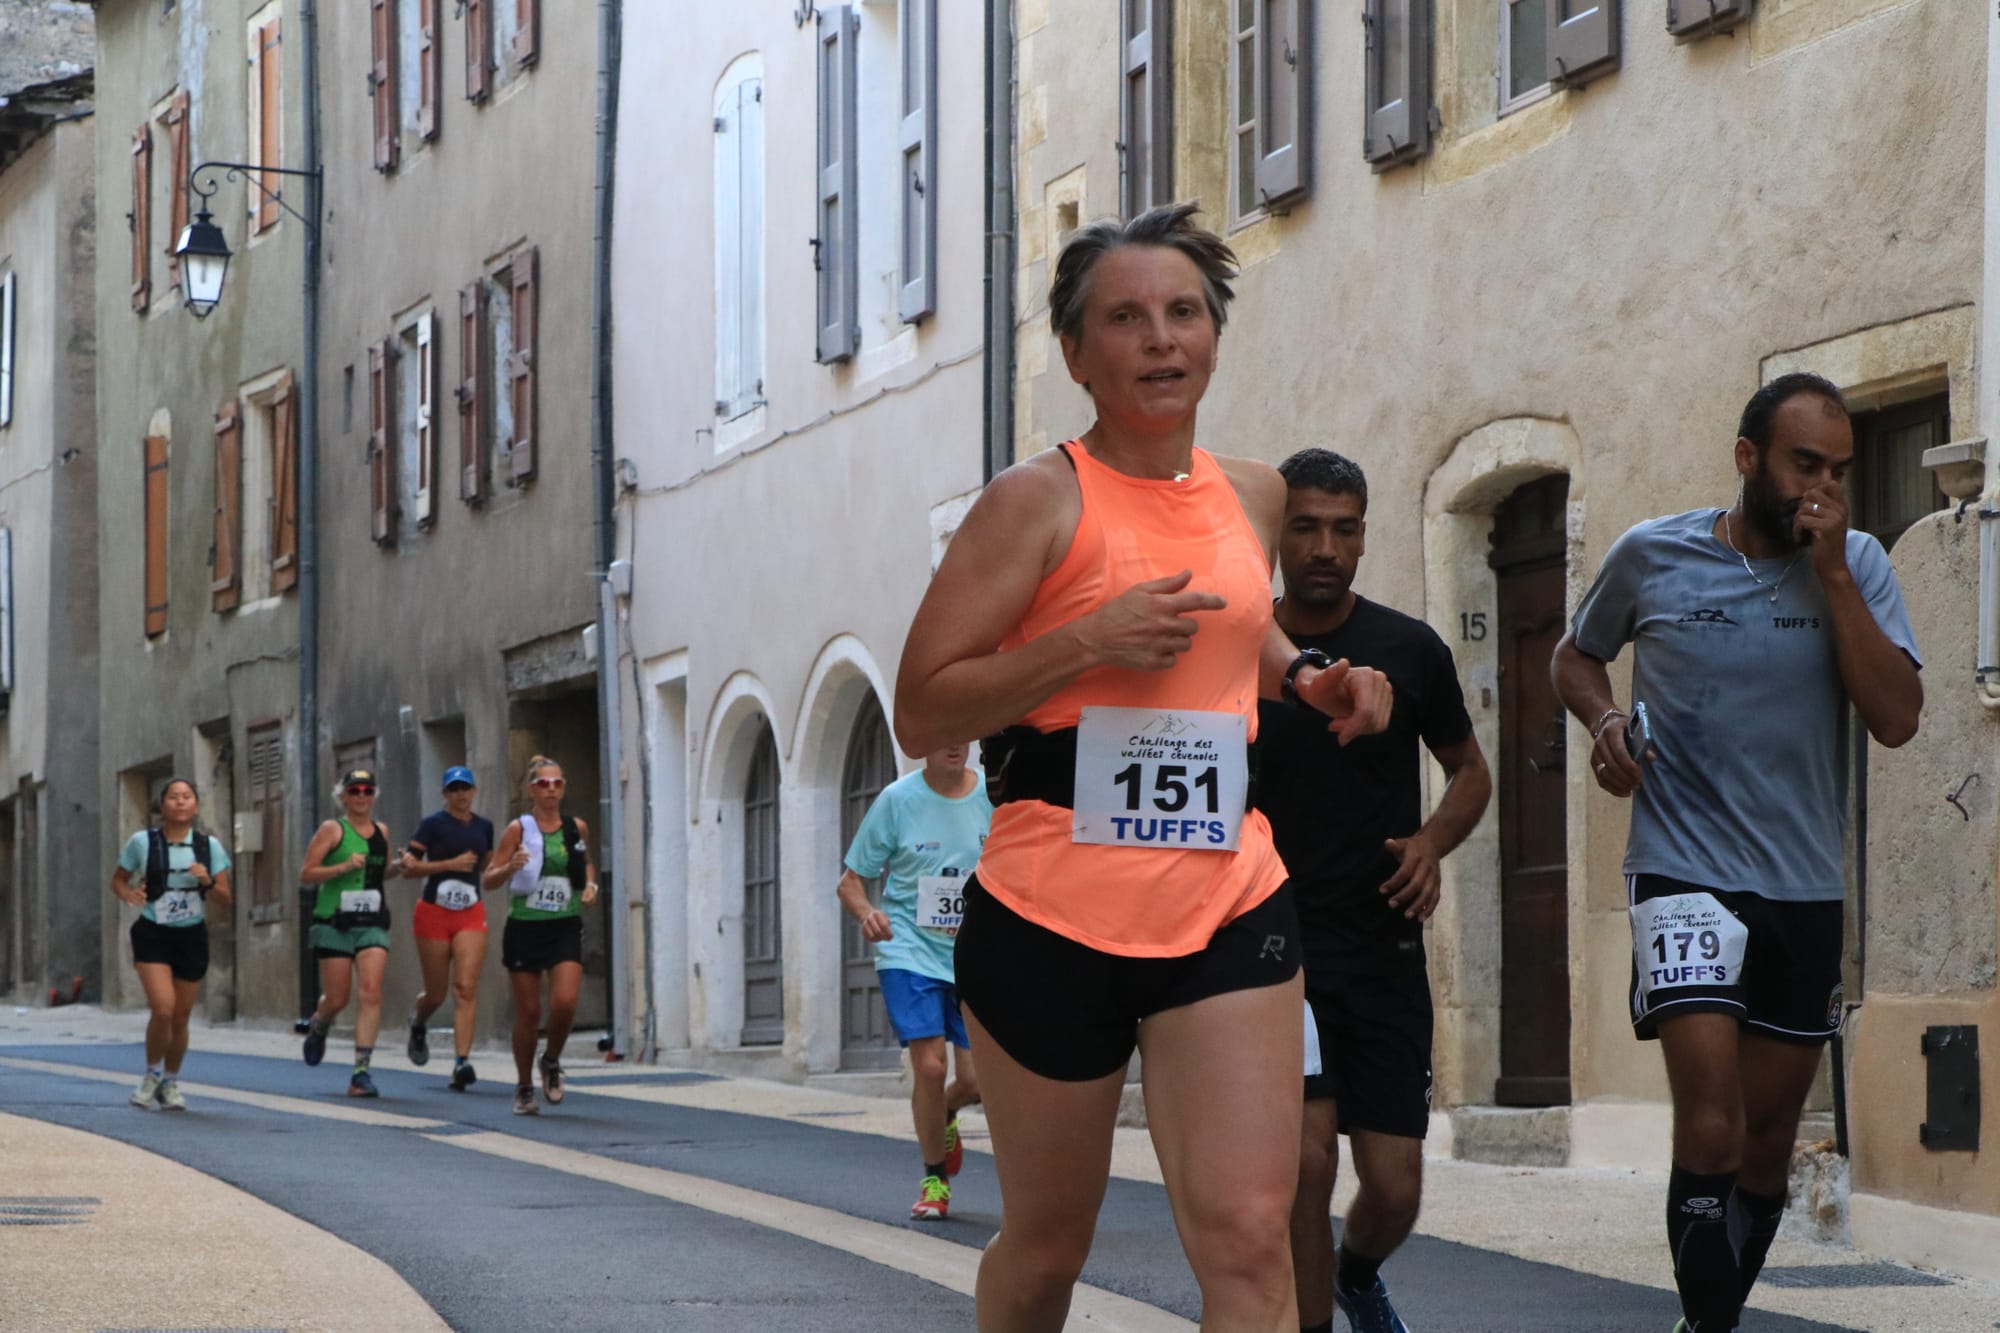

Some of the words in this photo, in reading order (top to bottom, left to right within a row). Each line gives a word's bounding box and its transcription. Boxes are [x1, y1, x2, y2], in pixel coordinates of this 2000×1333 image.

[1460, 612, 1487, 641] 15
[1772, 617, 1820, 629] TUFF'S
[1129, 736, 1188, 751] Challenge
[1194, 739, 1213, 749] des
[1121, 748, 1164, 759] vallées
[1170, 750, 1219, 761] cévenoles
[1114, 763, 1219, 813] 151
[1110, 817, 1226, 844] TUFF'S
[447, 891, 470, 905] 158
[538, 889, 565, 904] 149
[168, 898, 188, 913] 24
[938, 897, 965, 915] 30
[1653, 913, 1696, 923] Challenge
[1652, 930, 1721, 964] 179
[1650, 965, 1727, 986] TUFF'S
